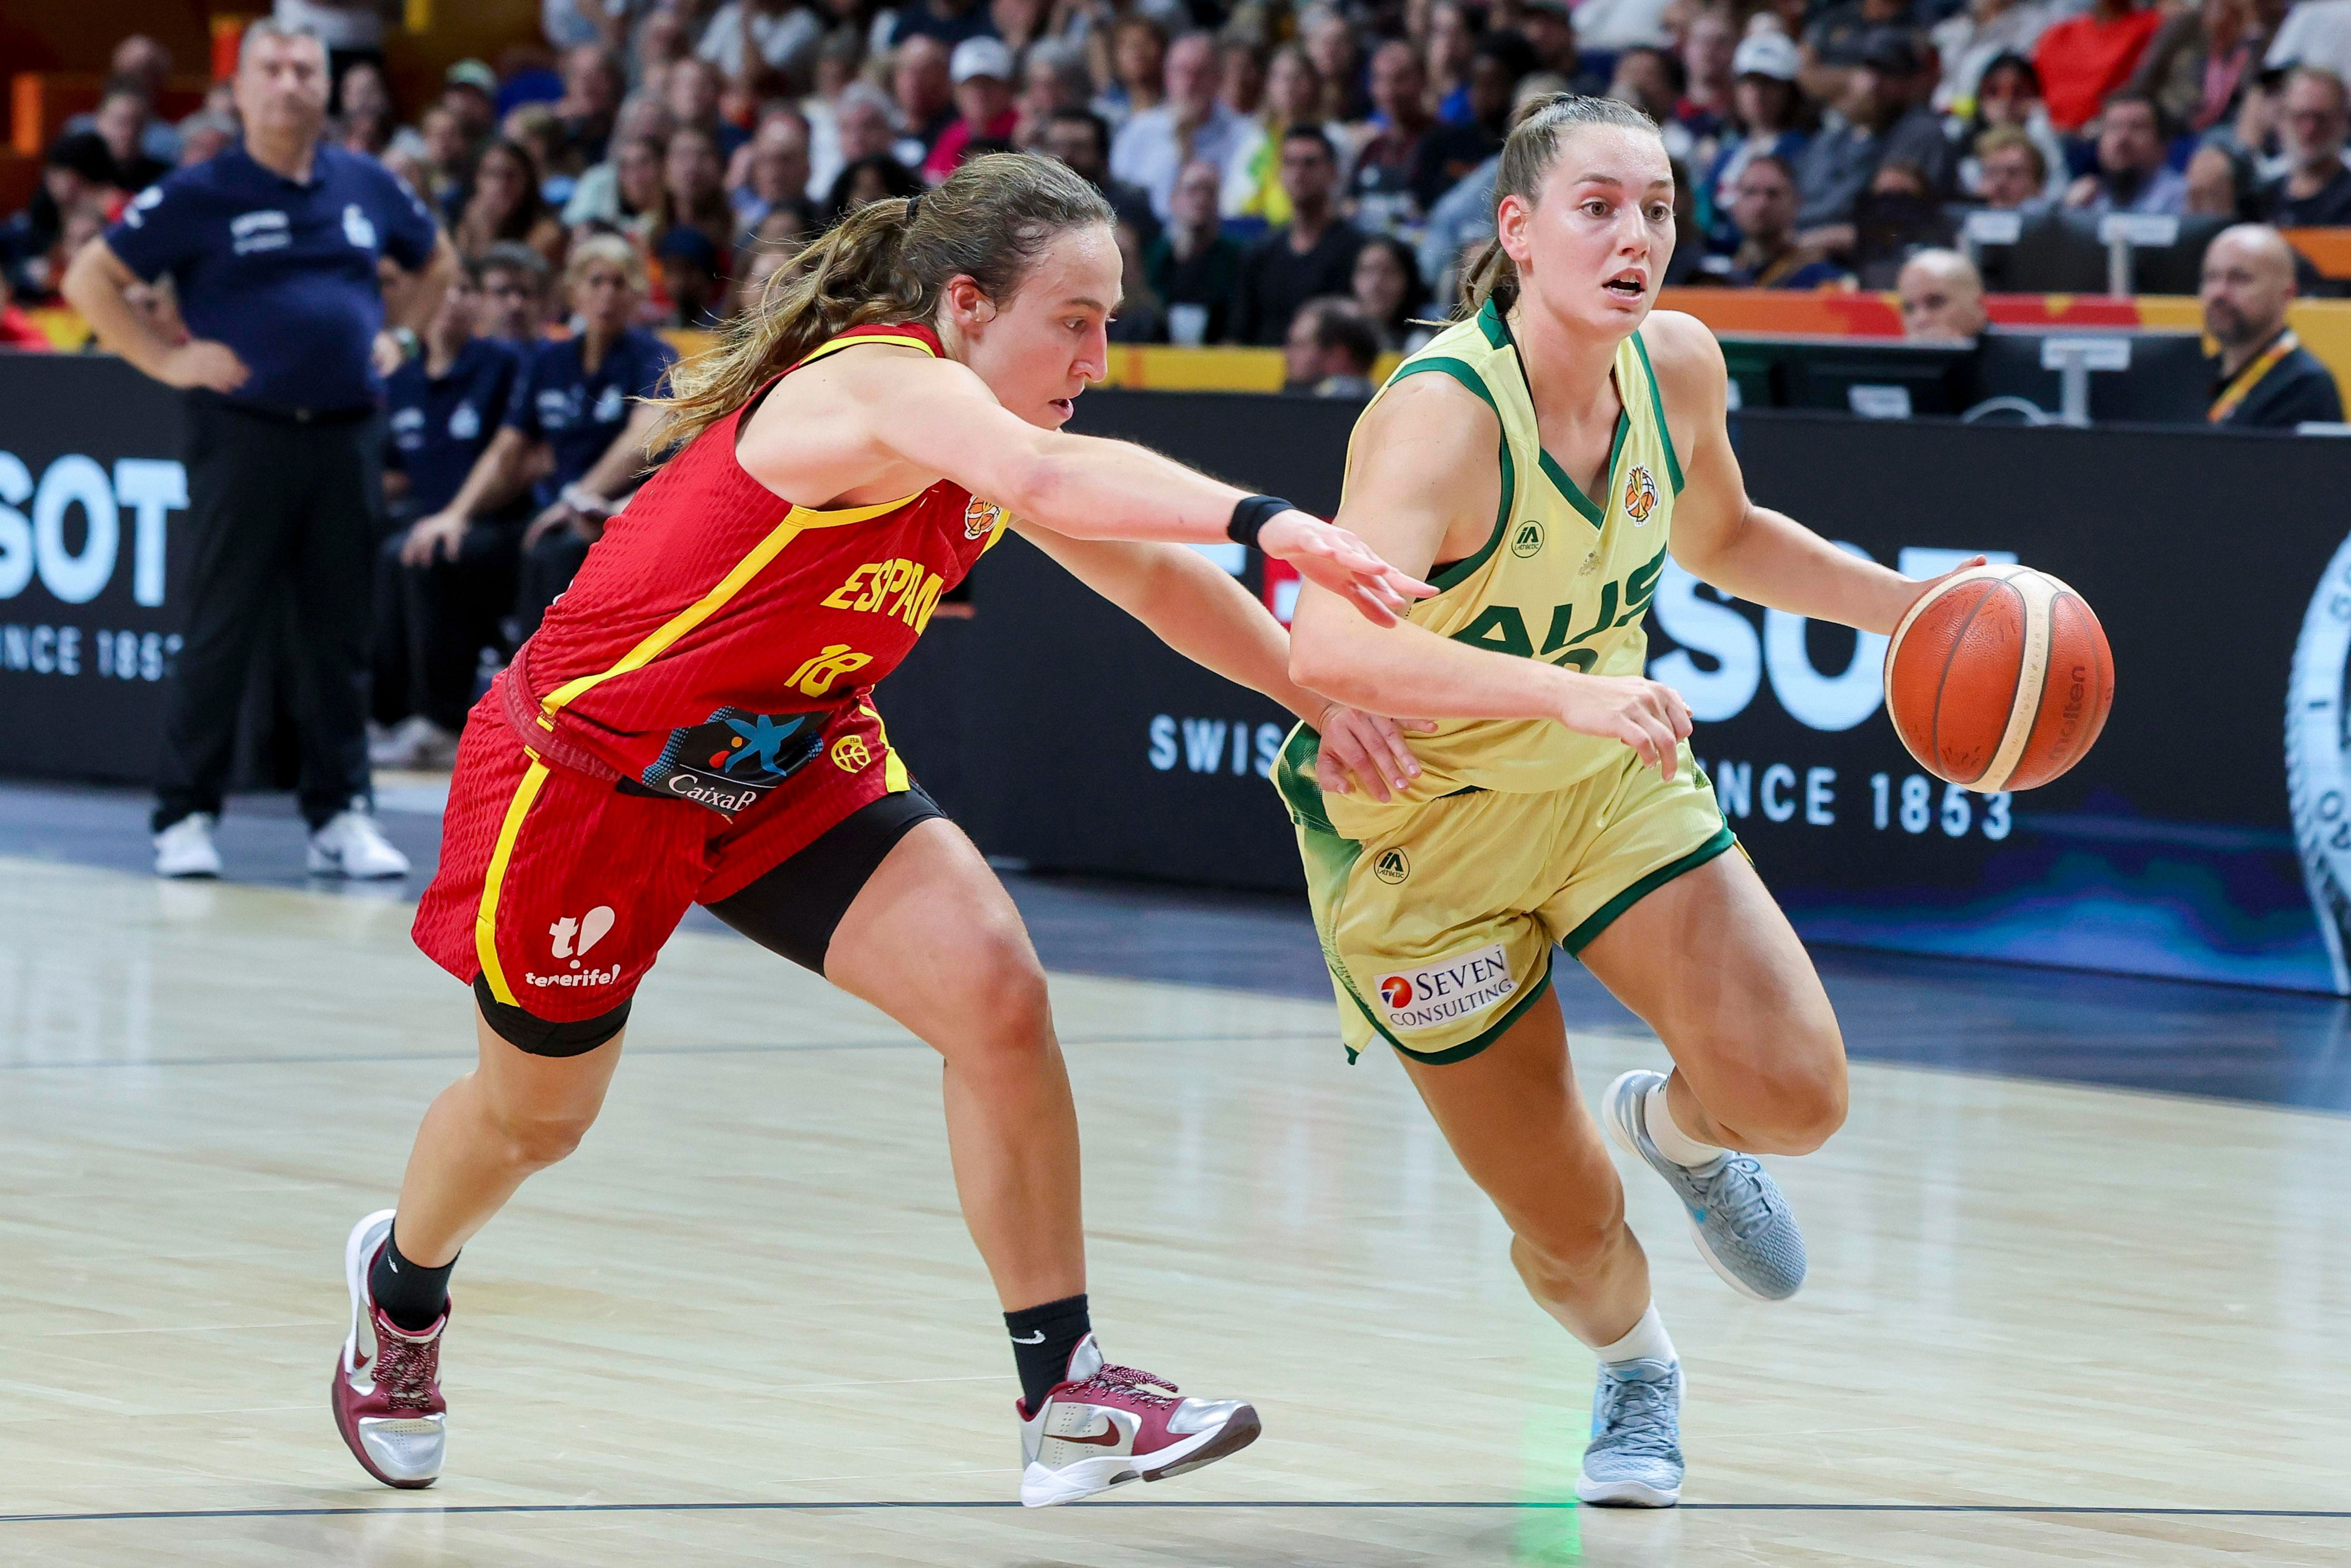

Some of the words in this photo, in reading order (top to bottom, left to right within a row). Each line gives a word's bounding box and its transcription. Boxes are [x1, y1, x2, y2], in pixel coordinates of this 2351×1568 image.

[1449, 540, 1667, 657] AUS
[0, 623, 82, 676] NCE
[784, 644, 873, 698] 18
[669, 774, 757, 812] CaixaB
[1695, 756, 1837, 826] NCE
[1871, 771, 2012, 840] 1853
[525, 964, 621, 988] tenerife!
[1416, 950, 1506, 1001] SEVEN
[1390, 978, 1513, 1026] CONSULTING
